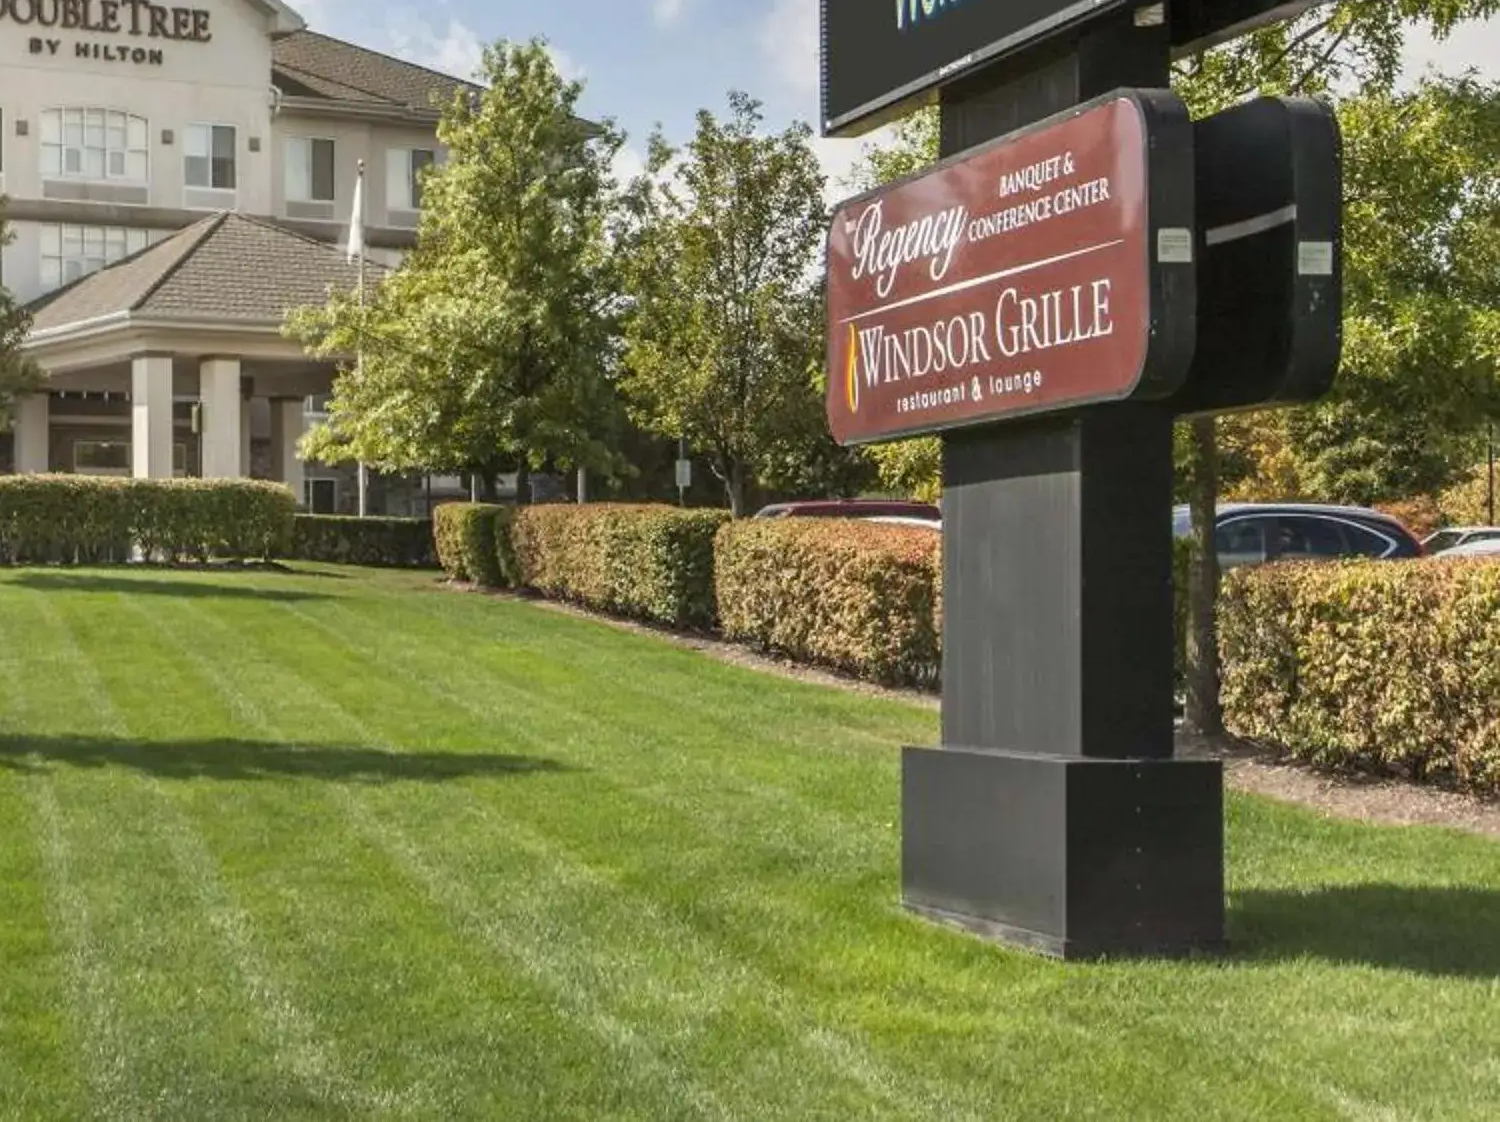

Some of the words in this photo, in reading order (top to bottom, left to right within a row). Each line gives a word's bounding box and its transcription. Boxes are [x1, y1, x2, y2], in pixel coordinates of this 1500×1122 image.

[28, 37, 61, 55] BY
[75, 41, 163, 66] HILTON
[999, 155, 1061, 198] BANQUET
[1063, 150, 1075, 175] &
[968, 195, 1052, 242] CONFERENCE
[1053, 177, 1110, 215] CENTER
[852, 199, 969, 298] Regency
[858, 311, 991, 389] WINDSOR
[996, 279, 1113, 358] GRILLE
[897, 381, 965, 413] restaurant
[971, 374, 983, 402] &
[989, 369, 1043, 394] lounge
